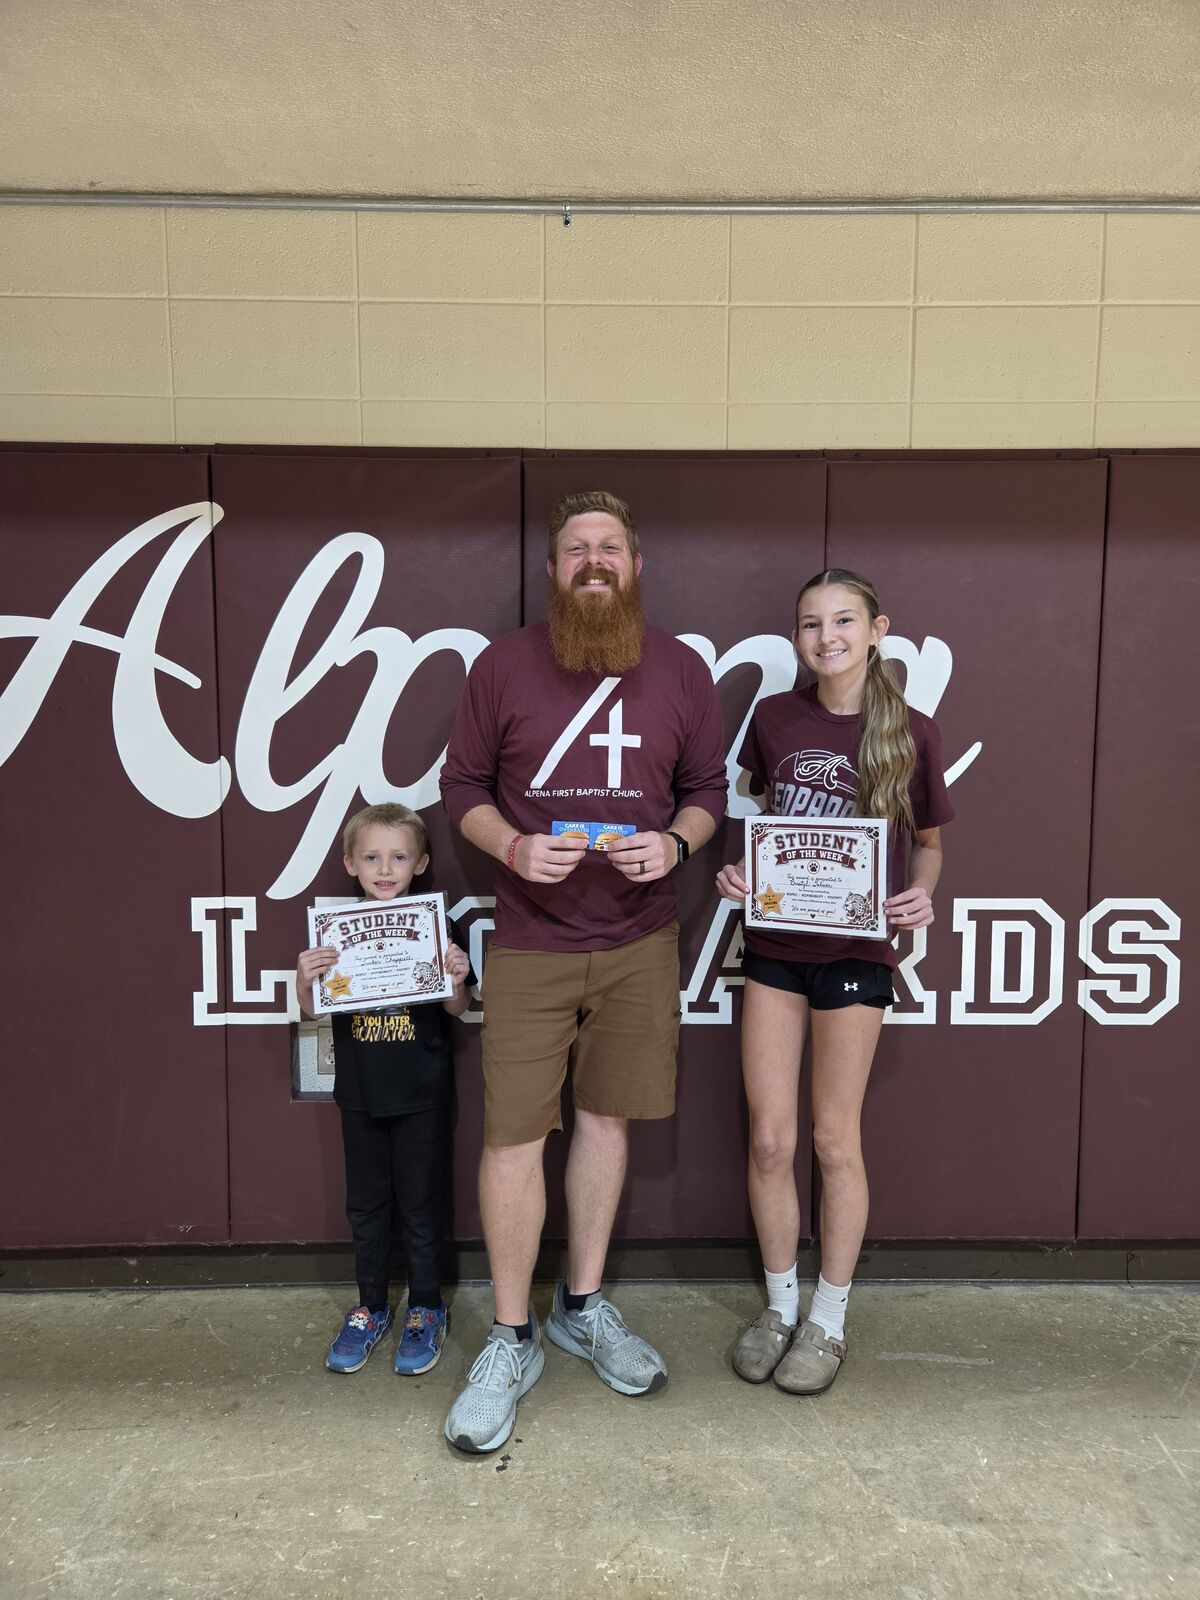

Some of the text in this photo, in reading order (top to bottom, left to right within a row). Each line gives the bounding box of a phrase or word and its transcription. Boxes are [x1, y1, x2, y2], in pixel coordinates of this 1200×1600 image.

[0, 501, 983, 900] Alpn
[524, 790, 551, 798] ALPENA
[552, 788, 575, 797] FIRST
[576, 788, 611, 797] BAPTIST
[774, 832, 859, 853] STUDENT
[786, 849, 844, 862] OF THE WEEK
[338, 912, 420, 936] STUDENT
[351, 928, 408, 943] OF THE WEEK
[362, 1015, 382, 1027] YOU
[384, 1015, 410, 1028] LATER
